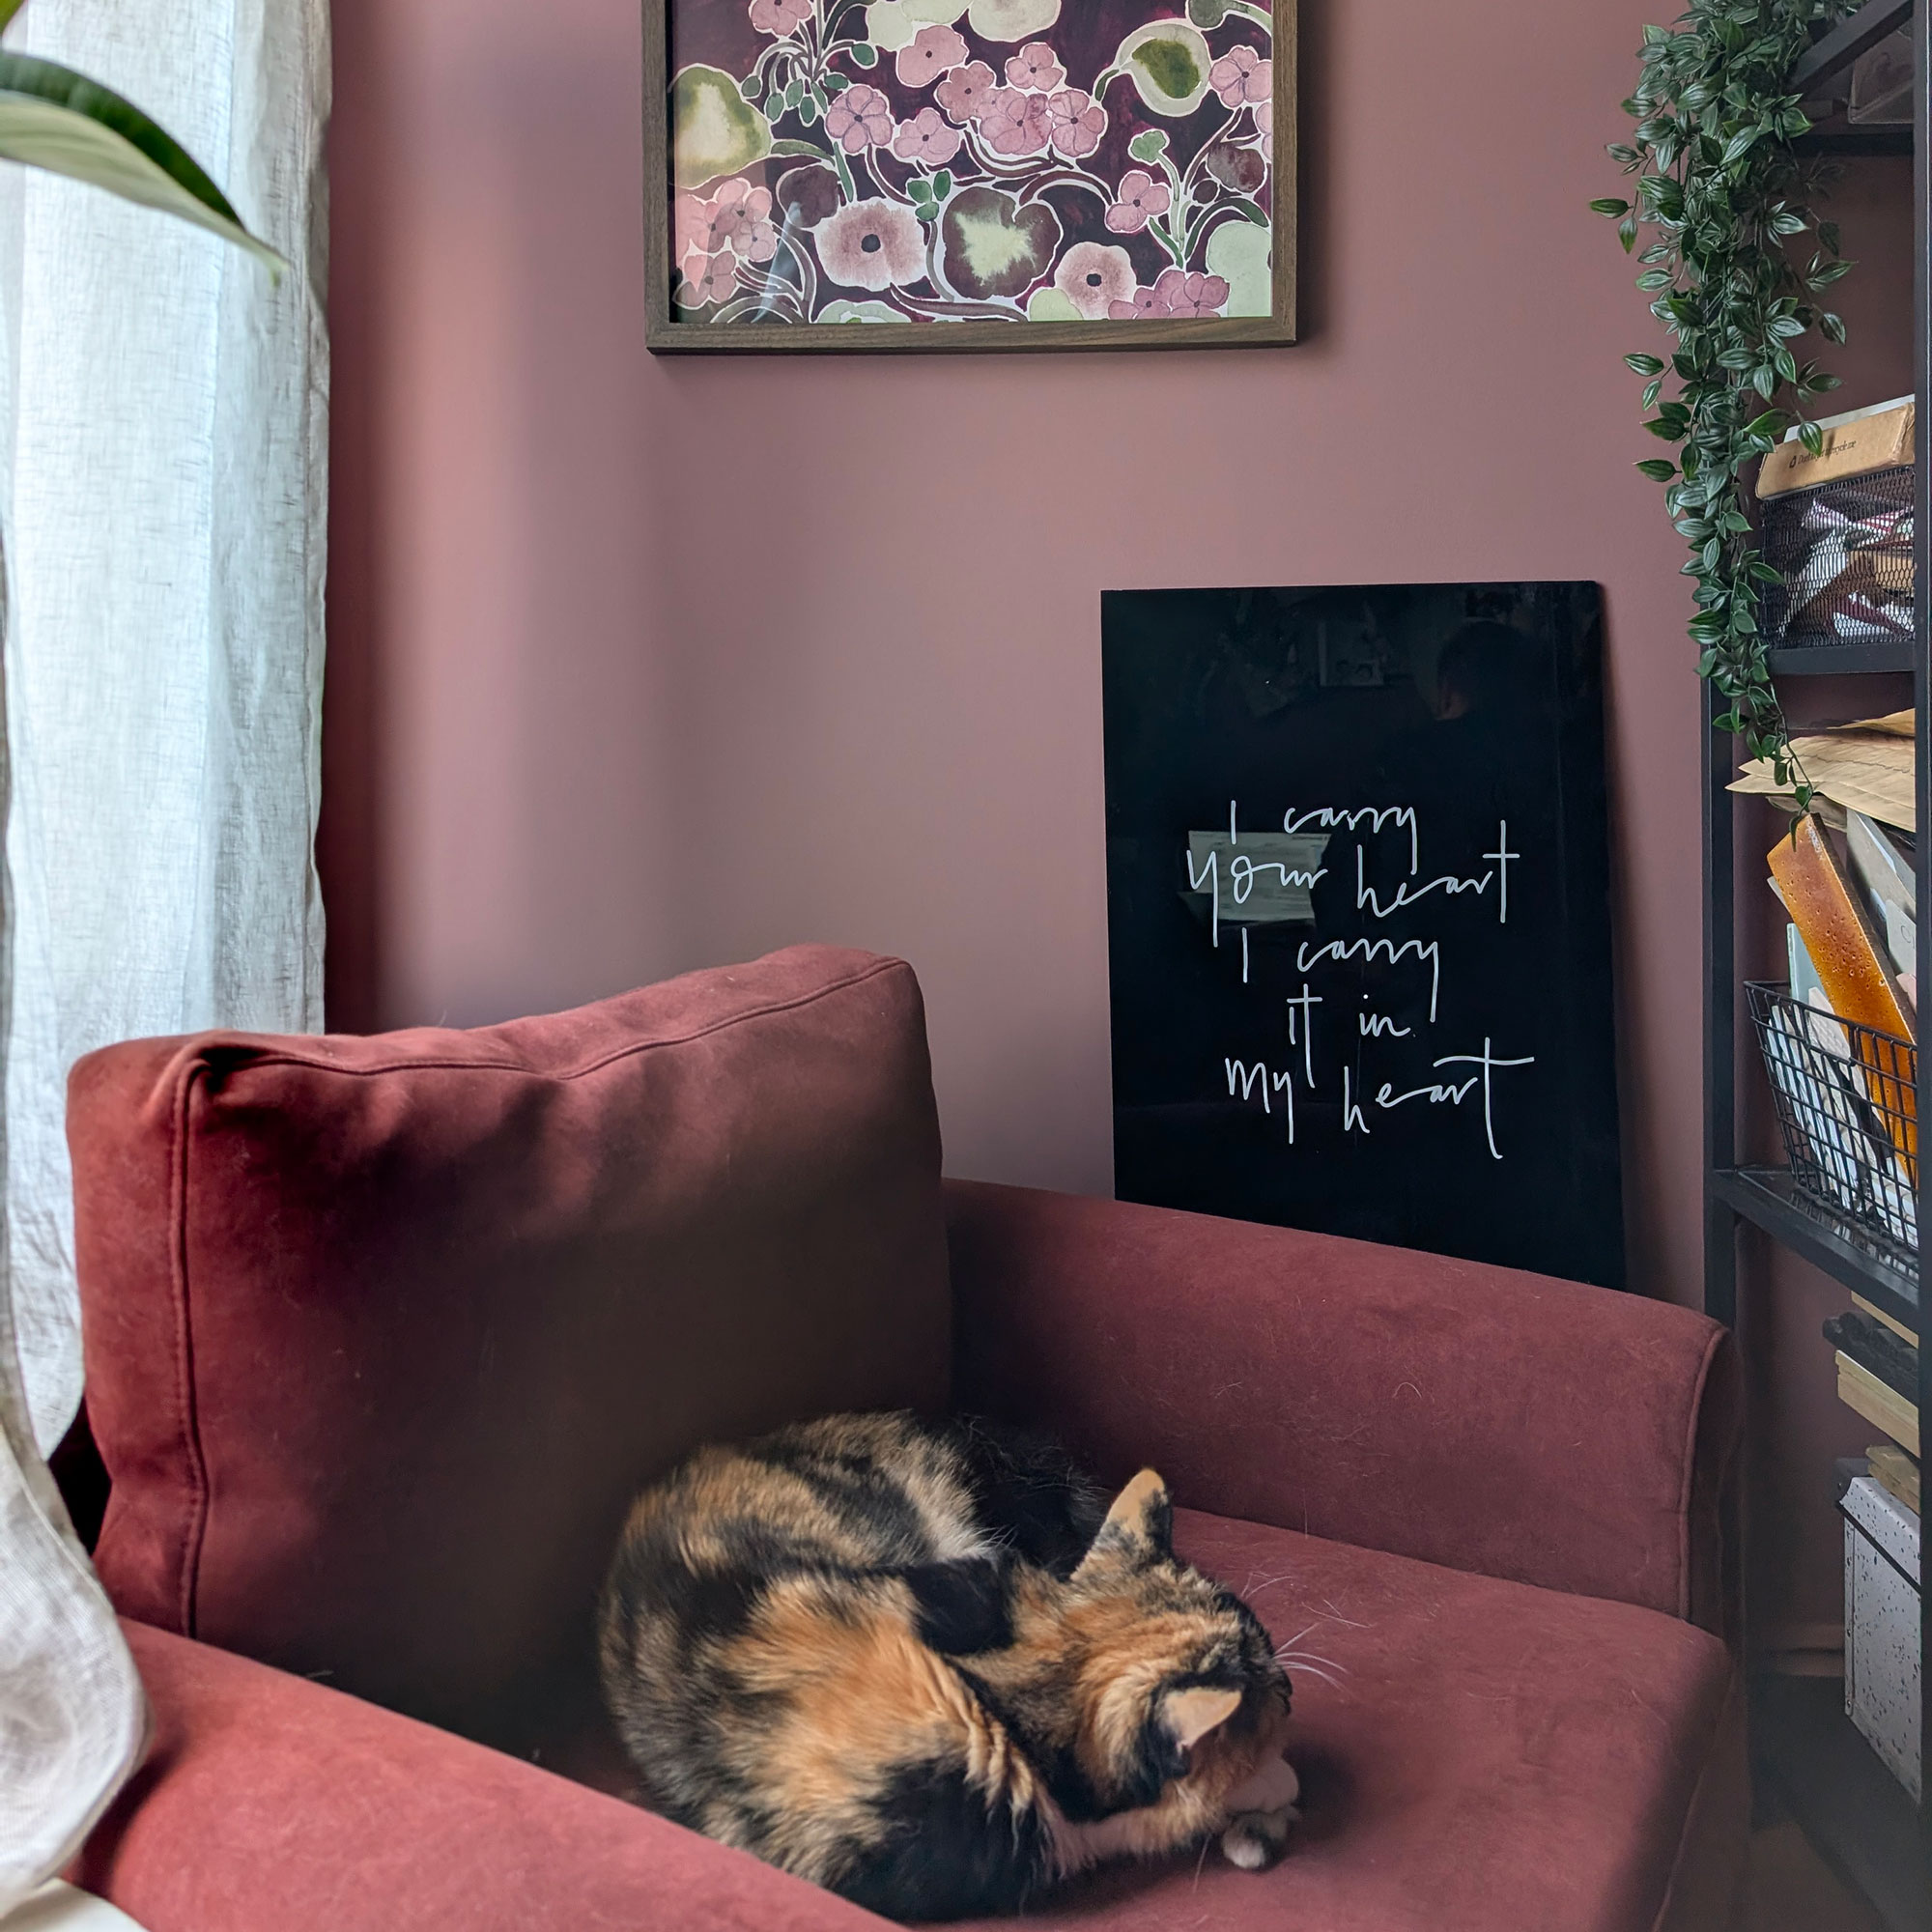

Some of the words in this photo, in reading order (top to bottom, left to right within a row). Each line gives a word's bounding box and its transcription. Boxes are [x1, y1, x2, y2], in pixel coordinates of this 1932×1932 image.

[1283, 806, 1418, 875] carry
[1356, 819, 1520, 923] heart
[1296, 938, 1439, 1023] carry
[1359, 994, 1411, 1037] in
[1344, 1037, 1535, 1160] heart
